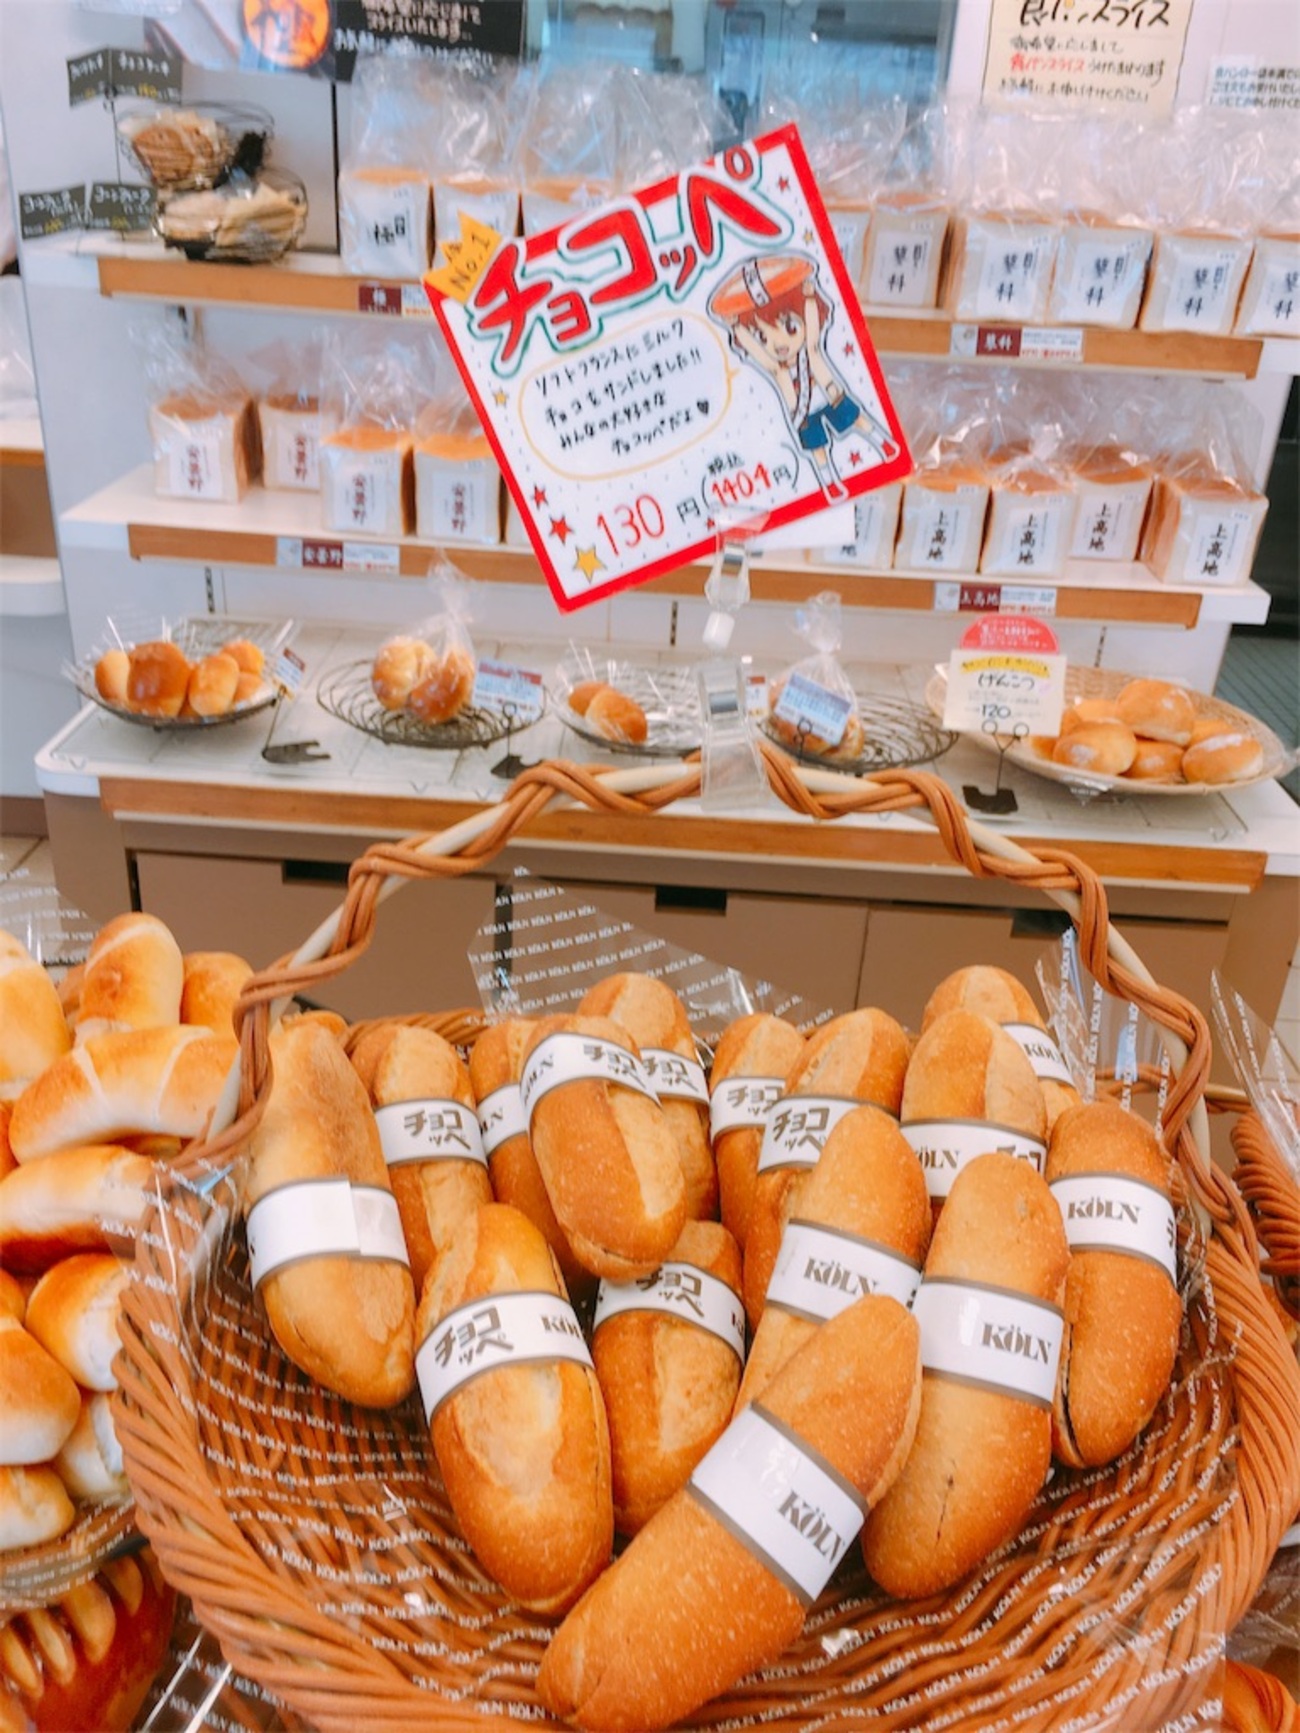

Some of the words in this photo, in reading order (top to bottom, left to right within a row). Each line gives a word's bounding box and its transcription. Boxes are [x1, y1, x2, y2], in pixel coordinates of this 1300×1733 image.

[474, 150, 783, 363] チョコッペ
[1067, 1196, 1142, 1226] KÖLN
[802, 1256, 880, 1297] KÖLN
[980, 1318, 1053, 1366] KÖLN
[777, 1488, 848, 1564] KÖLN
